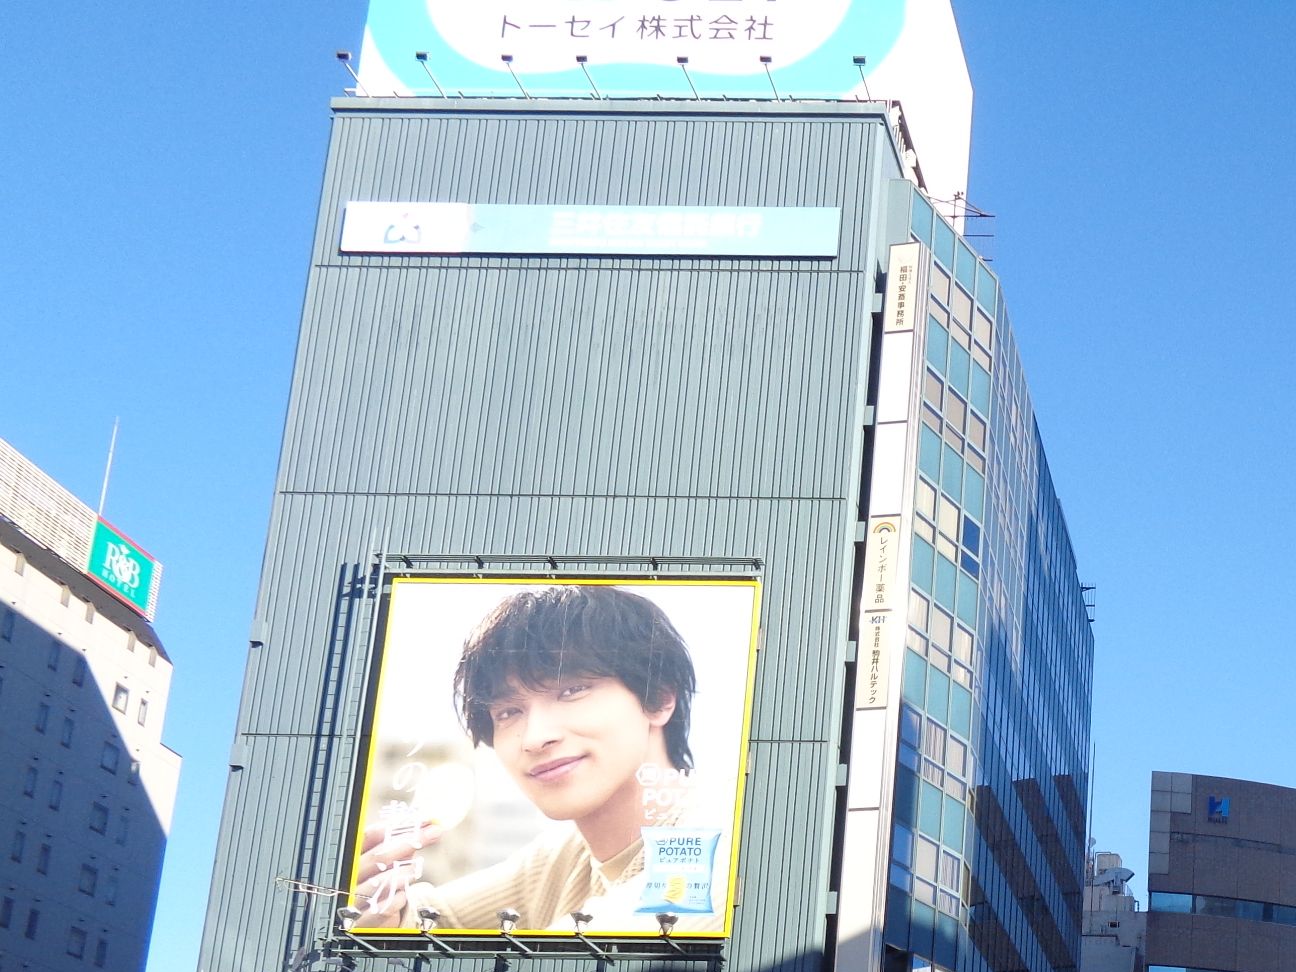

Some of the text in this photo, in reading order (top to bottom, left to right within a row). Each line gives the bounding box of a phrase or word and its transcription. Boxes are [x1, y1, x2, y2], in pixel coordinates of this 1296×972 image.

[501, 14, 774, 41] トーセイ株式会社
[101, 569, 137, 598] HOTEL
[875, 537, 888, 604] レインボー薬品
[658, 847, 702, 856] POTATO
[669, 837, 702, 846] PURE
